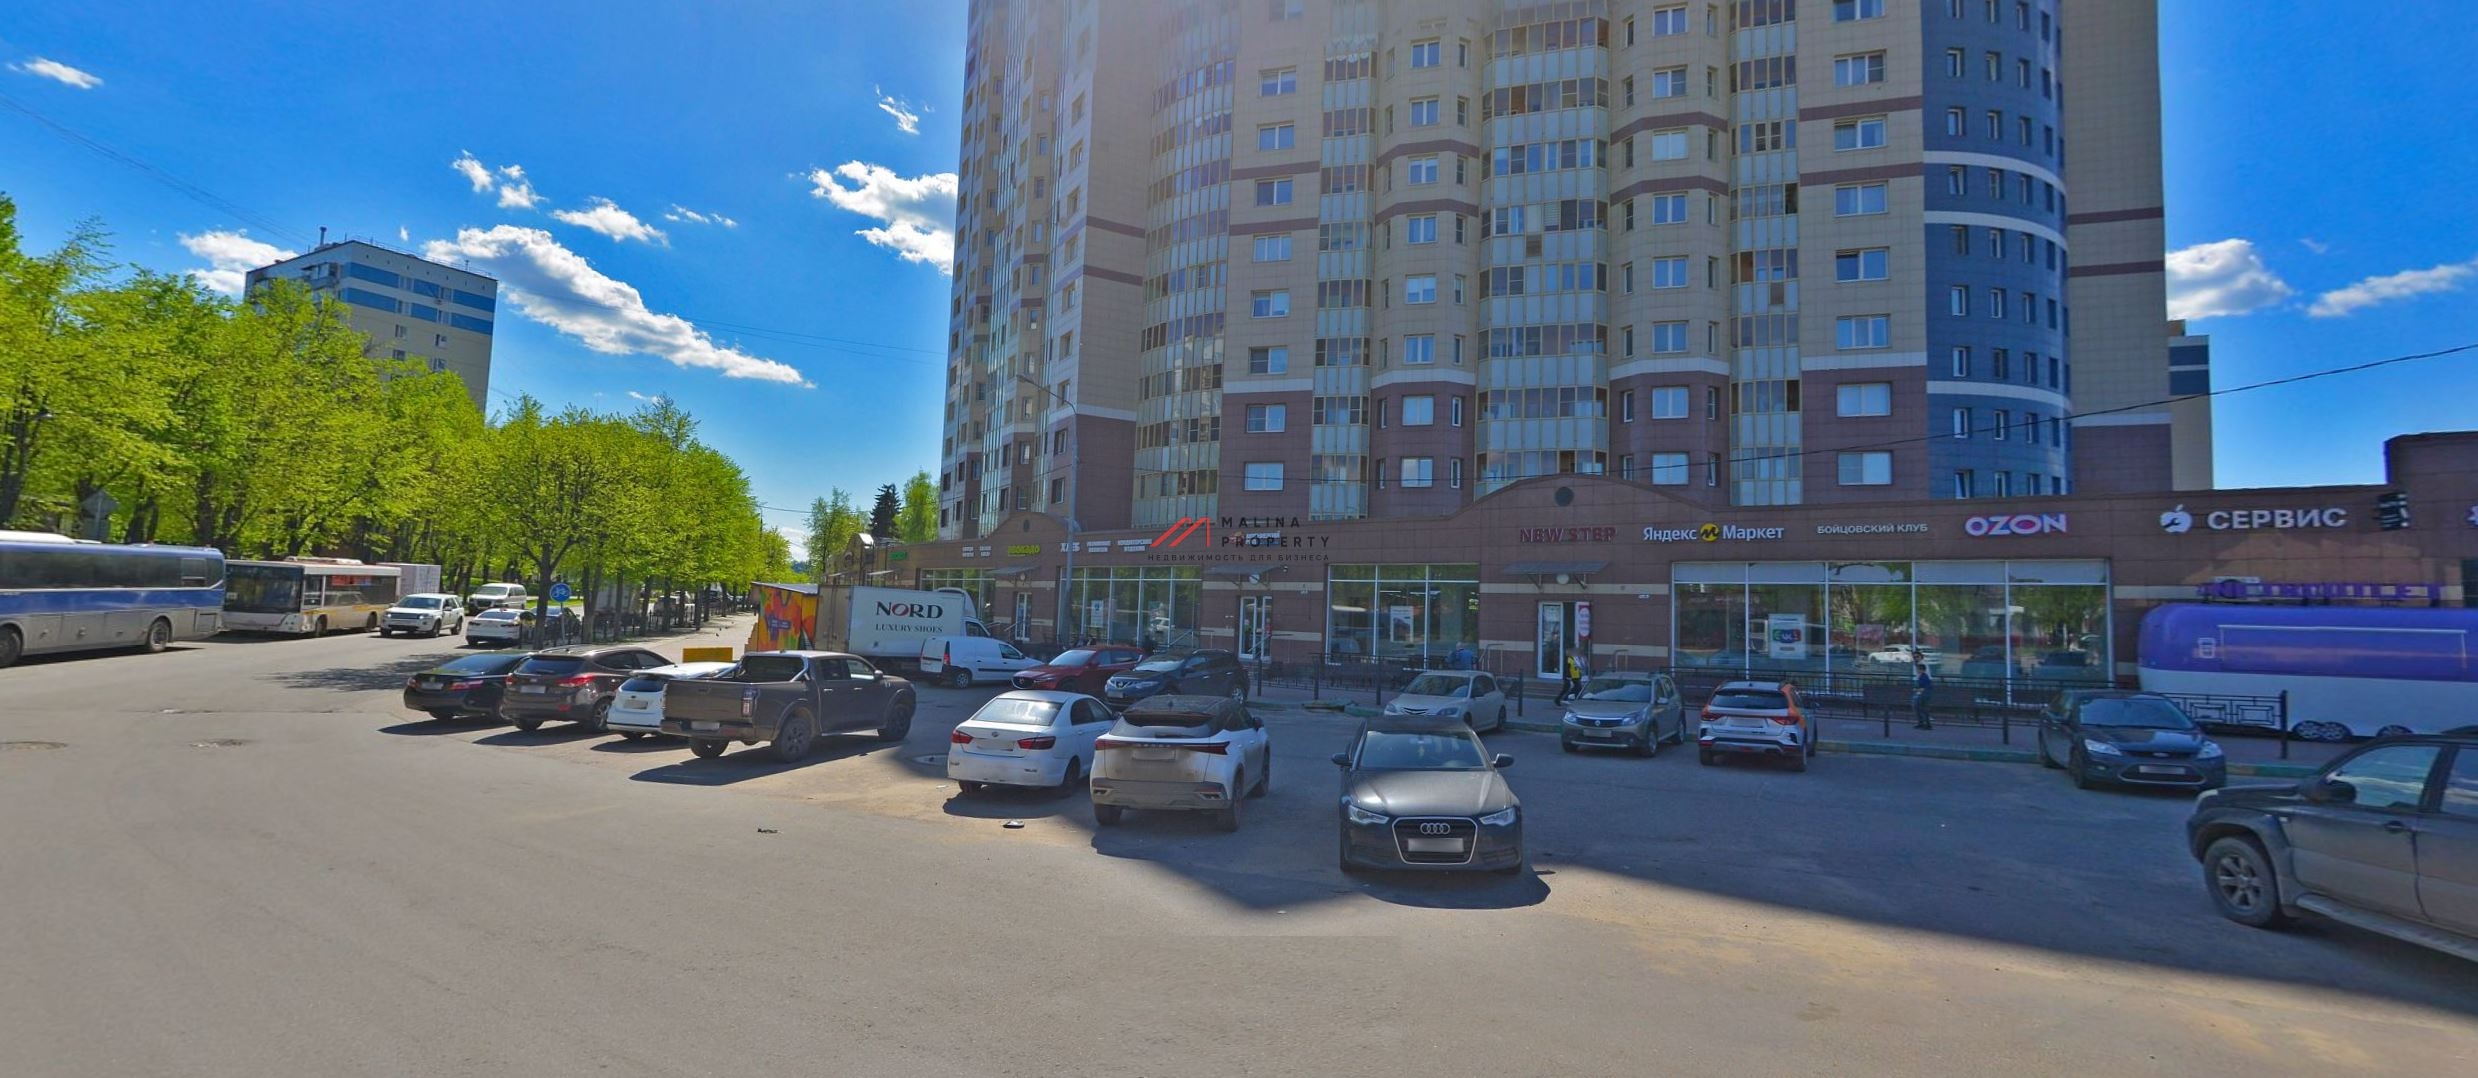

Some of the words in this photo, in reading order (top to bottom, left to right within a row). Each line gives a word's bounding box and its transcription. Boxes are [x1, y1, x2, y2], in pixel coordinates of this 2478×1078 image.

[1964, 513, 2068, 537] OZON
[2207, 507, 2348, 530] СЕРВИС
[1520, 526, 1565, 543] NEW
[1569, 526, 1617, 542] STEP
[1643, 526, 1697, 542] Яндекс
[1722, 524, 1785, 541] Маркет
[1817, 523, 1895, 535] БОЙЦОВСКИЙ
[1897, 523, 1929, 533] КЛУБ
[876, 601, 943, 619] NORD
[875, 623, 912, 632] LUXURY
[915, 625, 943, 633] SHOES
